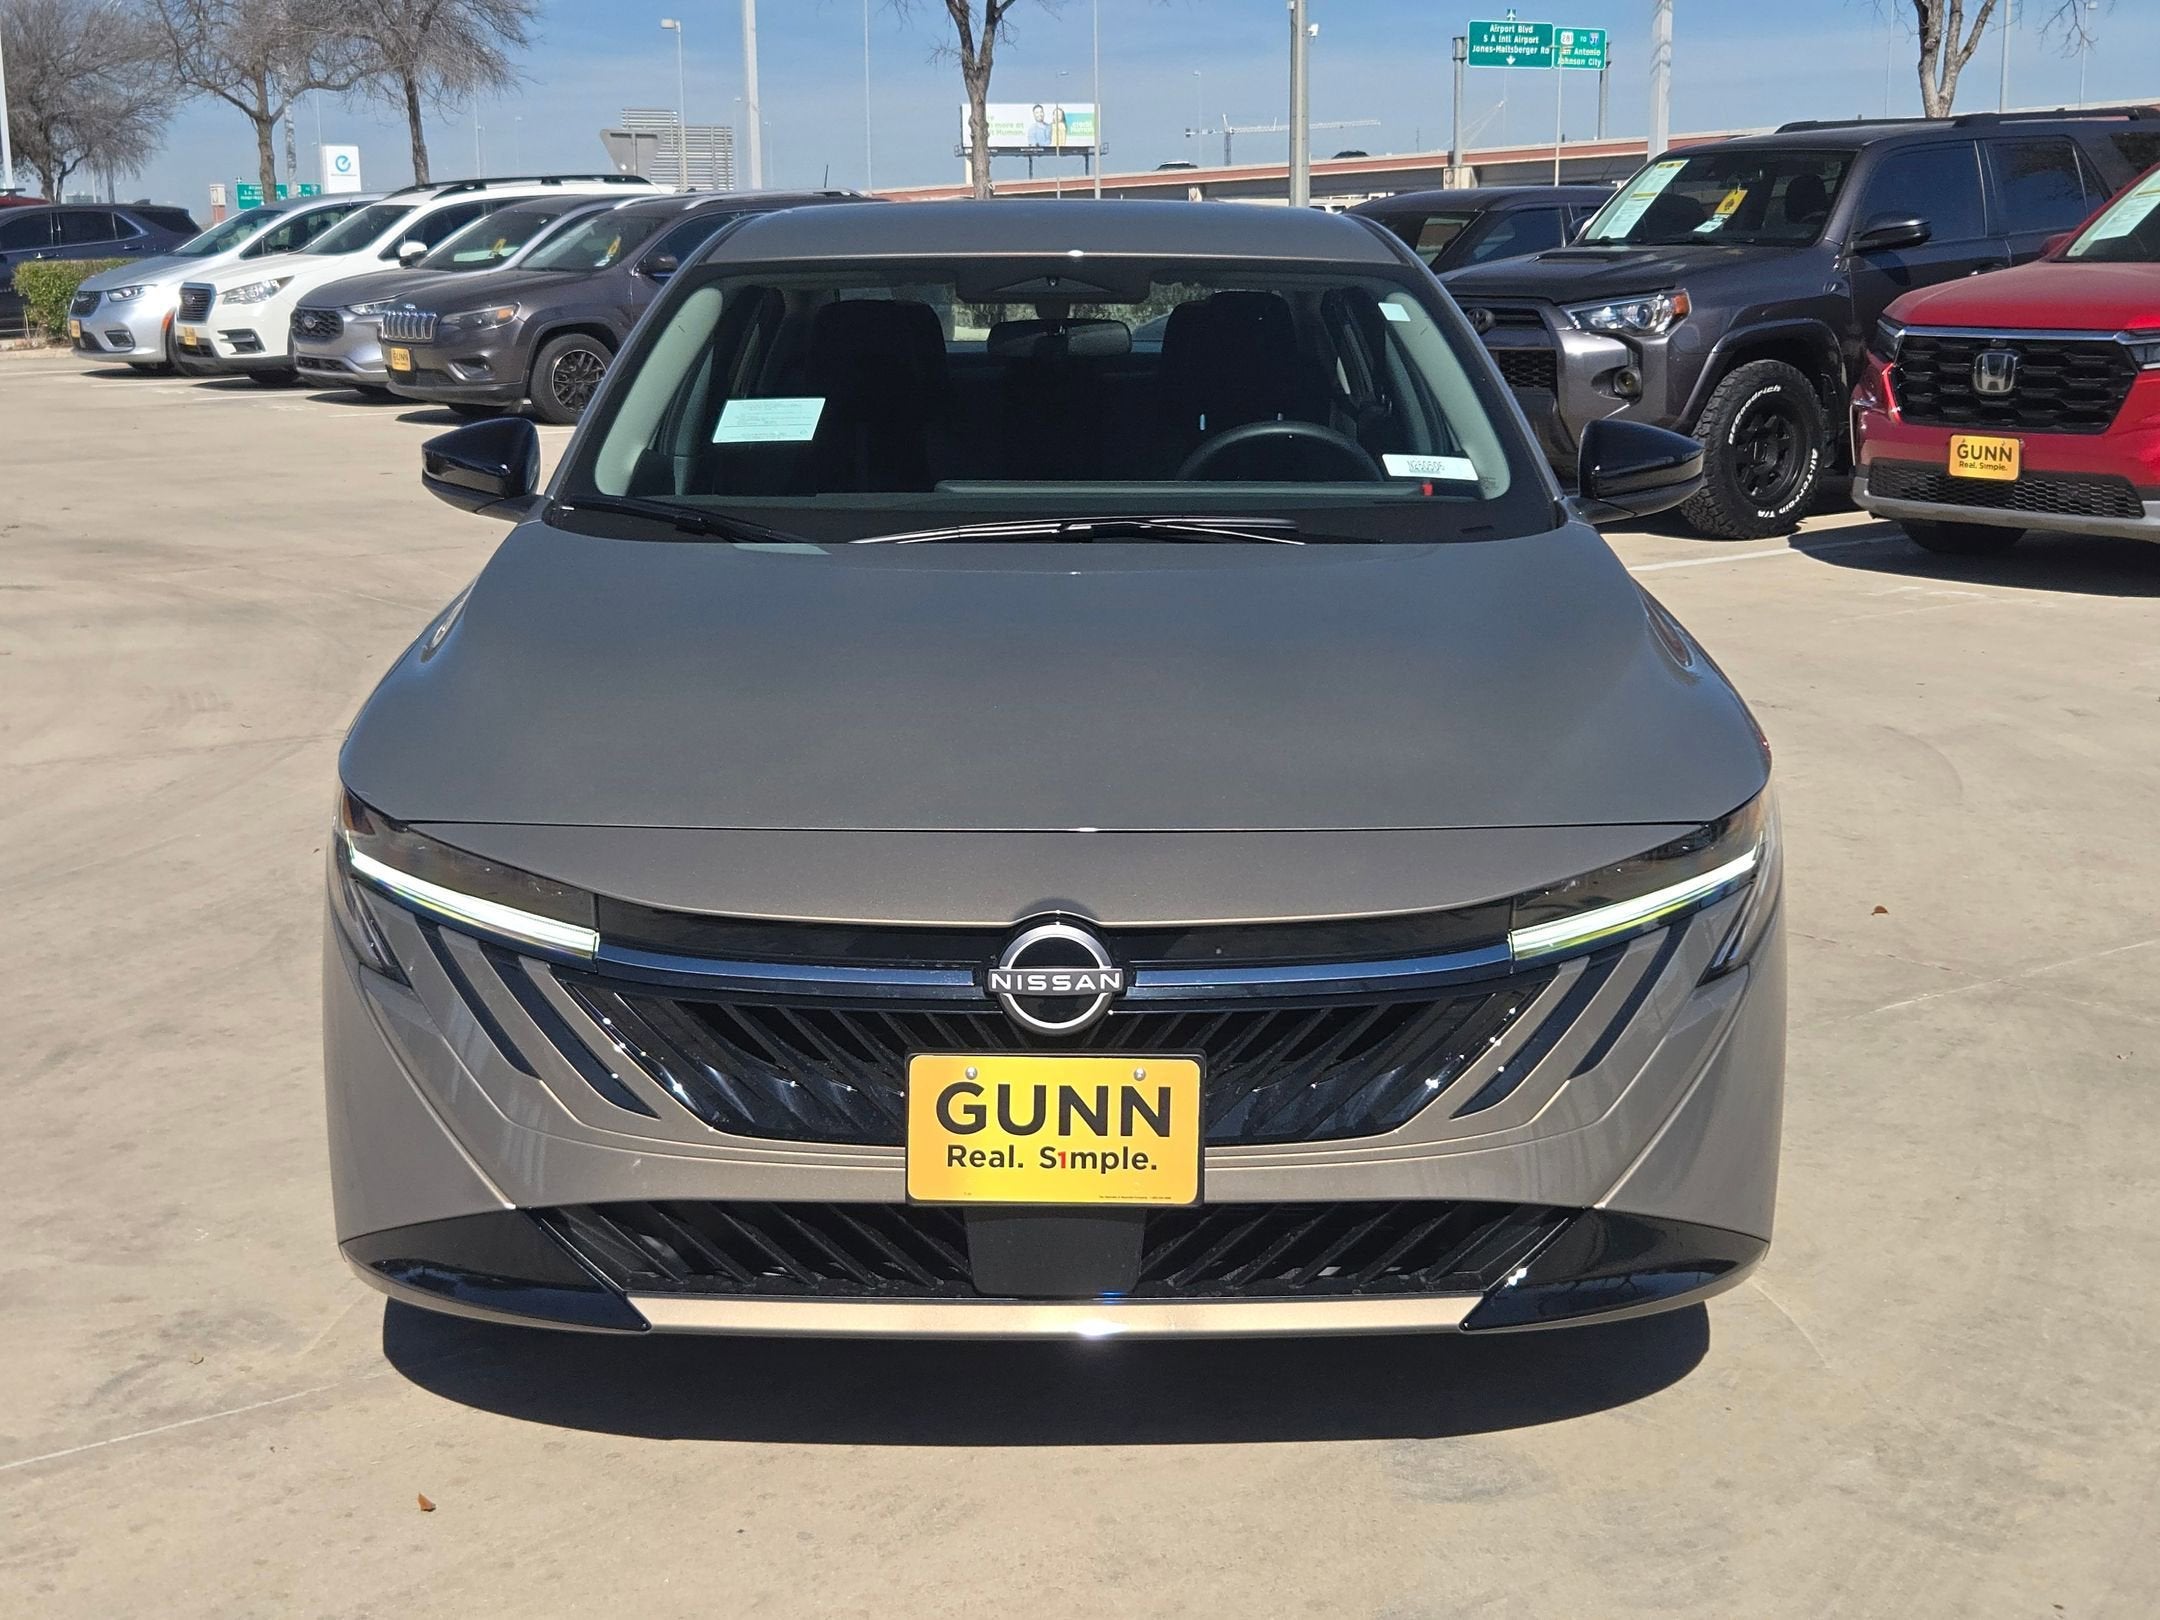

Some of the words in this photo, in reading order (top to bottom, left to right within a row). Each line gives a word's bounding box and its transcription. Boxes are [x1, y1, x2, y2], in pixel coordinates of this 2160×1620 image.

[1490, 24, 1515, 33] Airport
[1518, 25, 1534, 34] Blvd
[1483, 34, 1488, 43] S
[1490, 34, 1496, 43] A
[1498, 35, 1511, 43] Intl
[1514, 36, 1539, 45] Airport
[1472, 45, 1538, 56] Jones-Maltsberger
[1574, 48, 1602, 57] Antonio
[1588, 58, 1602, 68] City
[1956, 443, 2013, 463] GUNN
[1959, 460, 1978, 469] Real.
[991, 972, 1120, 991] NISSAN
[936, 1081, 1171, 1137] GUNN
[947, 1144, 1024, 1169] Real.
